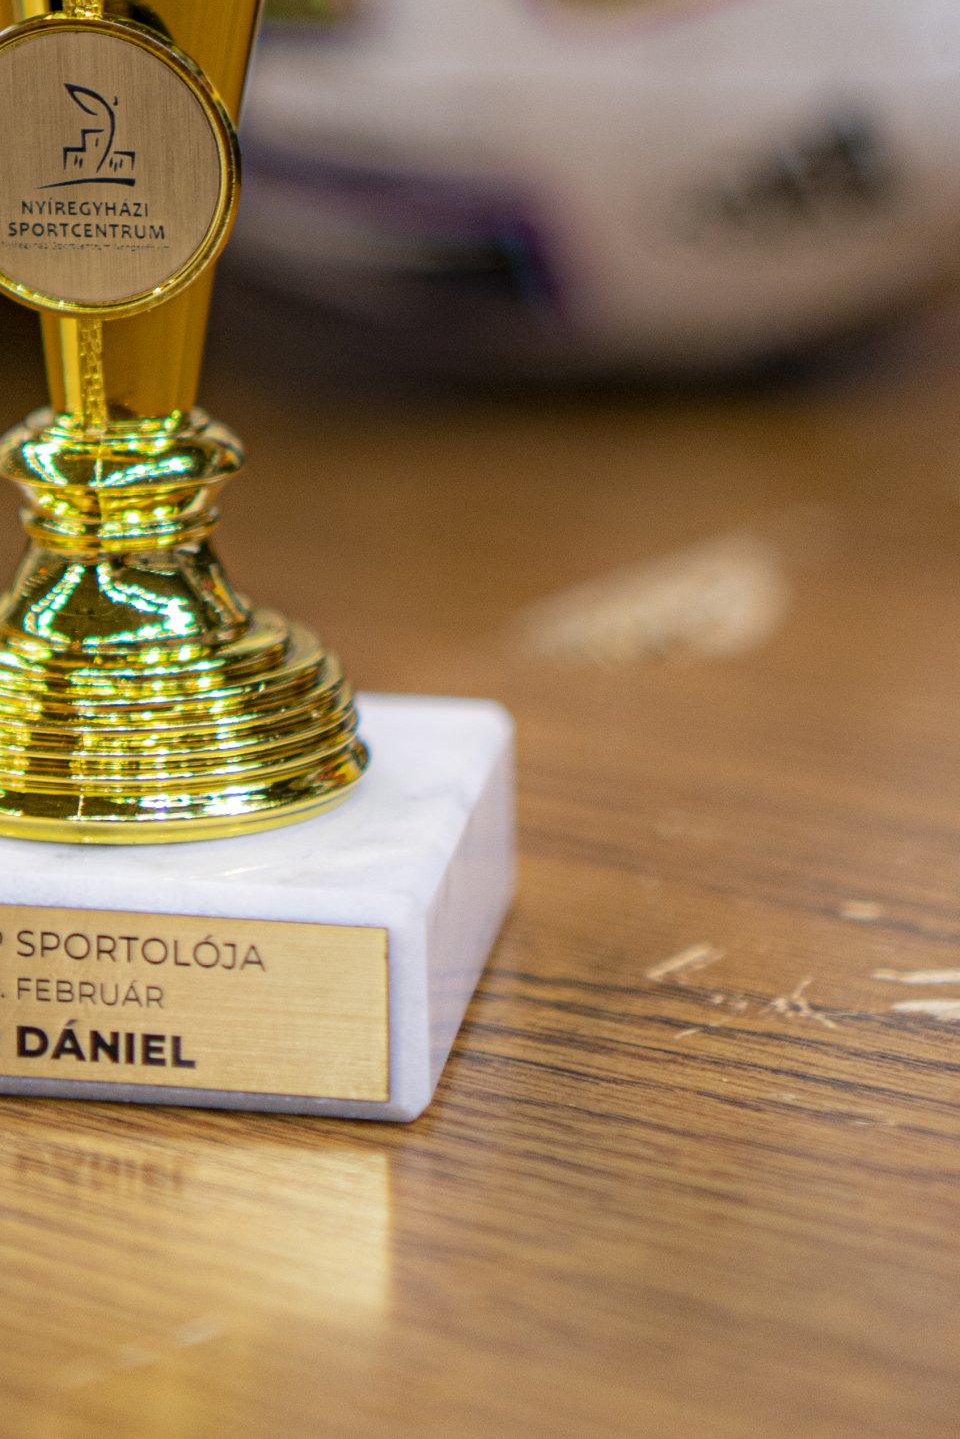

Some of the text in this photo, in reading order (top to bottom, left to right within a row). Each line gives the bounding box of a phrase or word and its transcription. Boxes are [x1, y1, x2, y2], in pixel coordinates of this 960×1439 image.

[21, 198, 148, 217] NYÍREGYHÁZI
[8, 222, 166, 239] SPORTCENTRUM
[16, 930, 266, 971] SPORTOLÓJA
[17, 977, 164, 1008] FEBRUÁR
[17, 1019, 196, 1068] DÁNIEL
